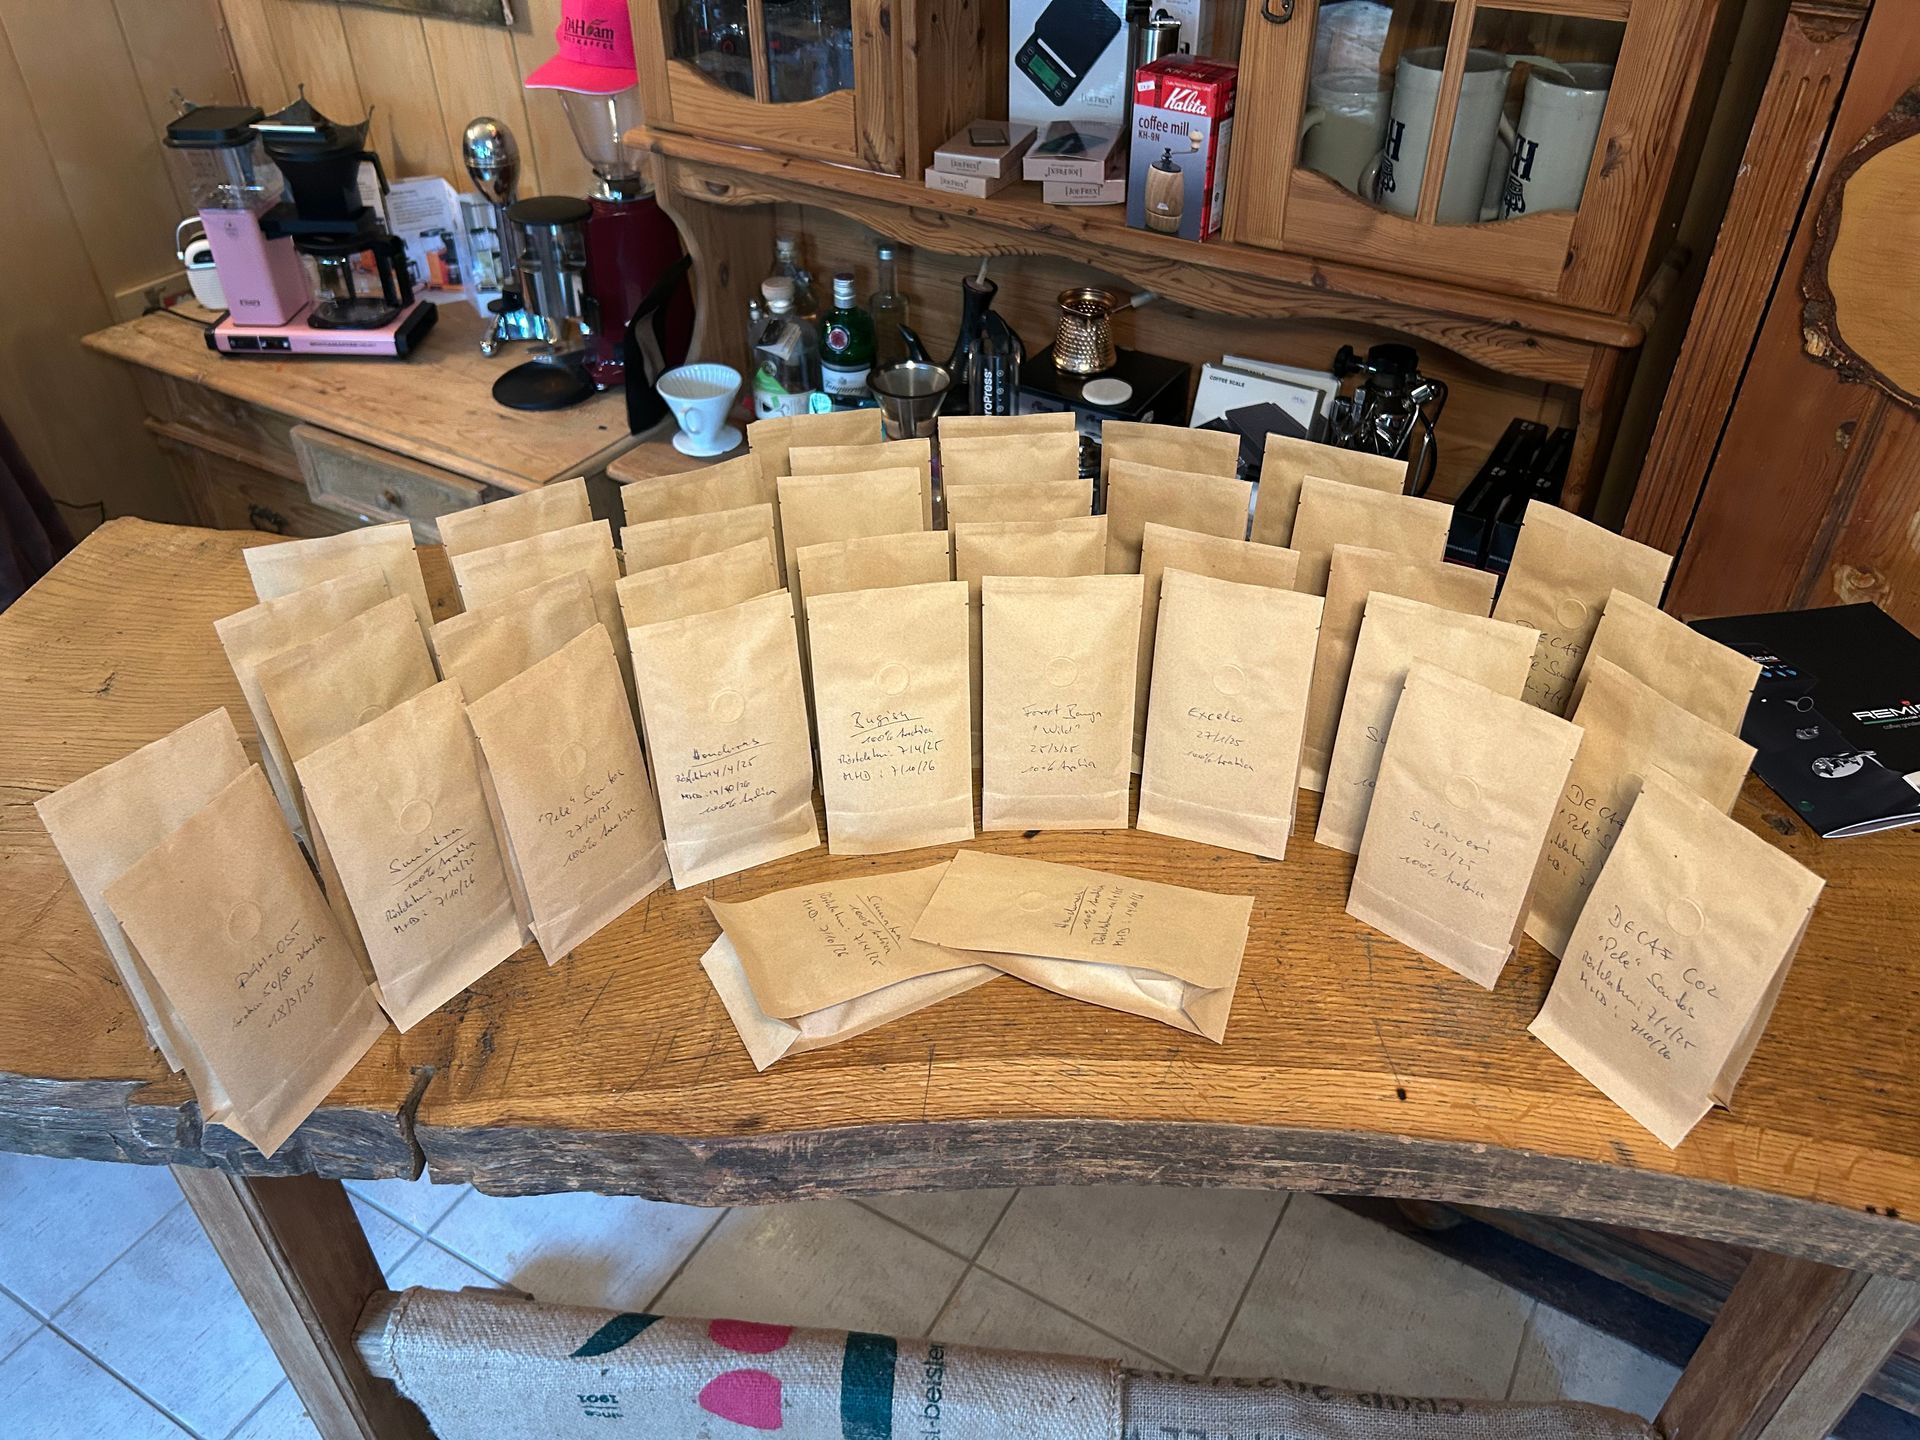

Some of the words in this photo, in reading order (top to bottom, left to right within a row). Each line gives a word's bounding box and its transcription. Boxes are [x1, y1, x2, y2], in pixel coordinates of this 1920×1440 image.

[1164, 87, 1208, 115] Kalita
[1138, 115, 1169, 131] coffee
[1170, 121, 1190, 137] mill
[1209, 374, 1228, 385] COFFEE
[1229, 379, 1245, 388] SCALE
[1187, 706, 1244, 723] Excelso
